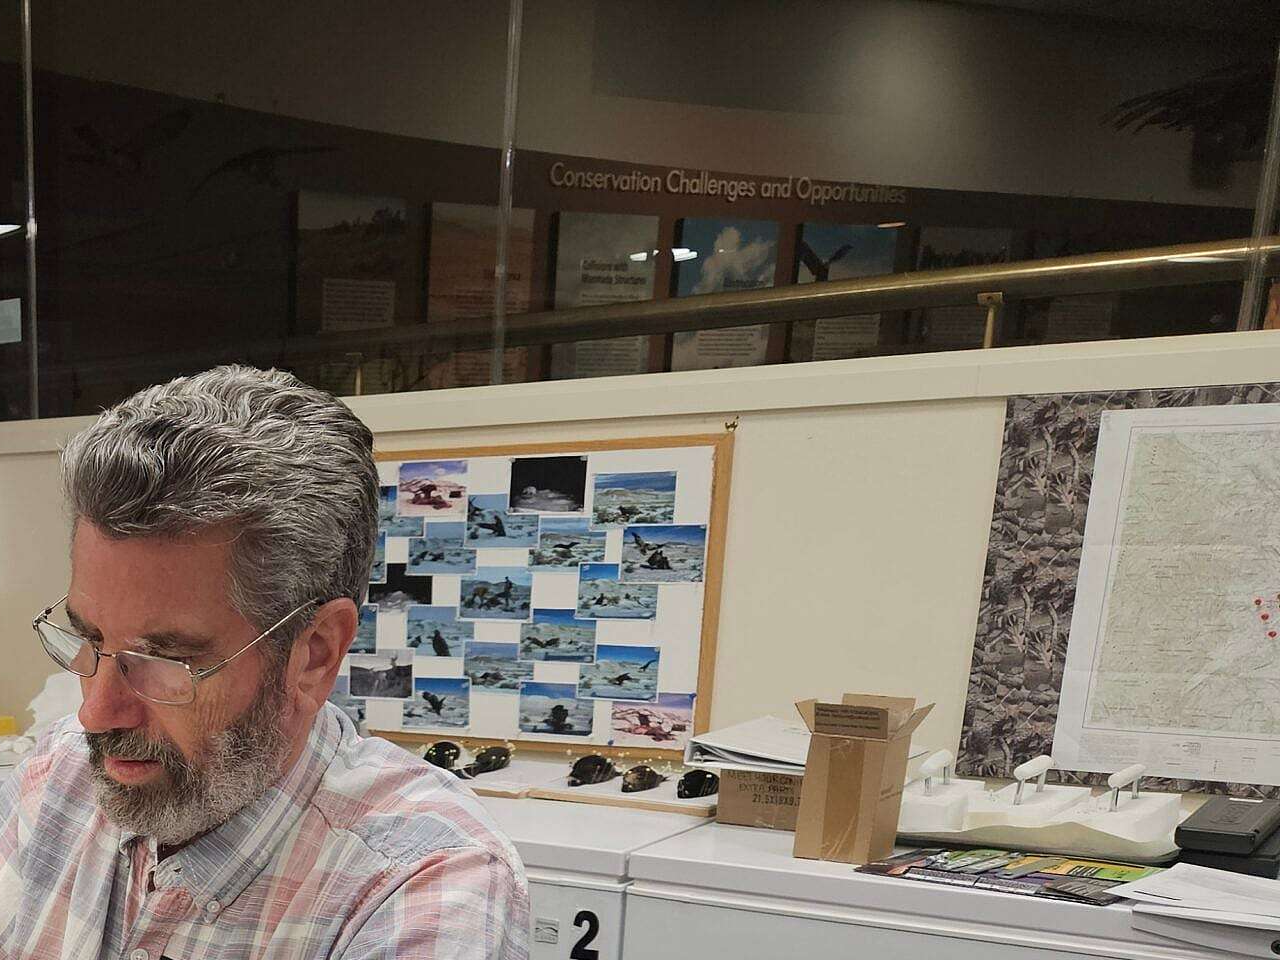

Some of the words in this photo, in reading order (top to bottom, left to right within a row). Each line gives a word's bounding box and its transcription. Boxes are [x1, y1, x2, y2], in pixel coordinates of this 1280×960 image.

[550, 162, 661, 194] Conservation
[666, 169, 756, 202] Challenges
[760, 177, 792, 199] and
[796, 177, 907, 206] Opportunities
